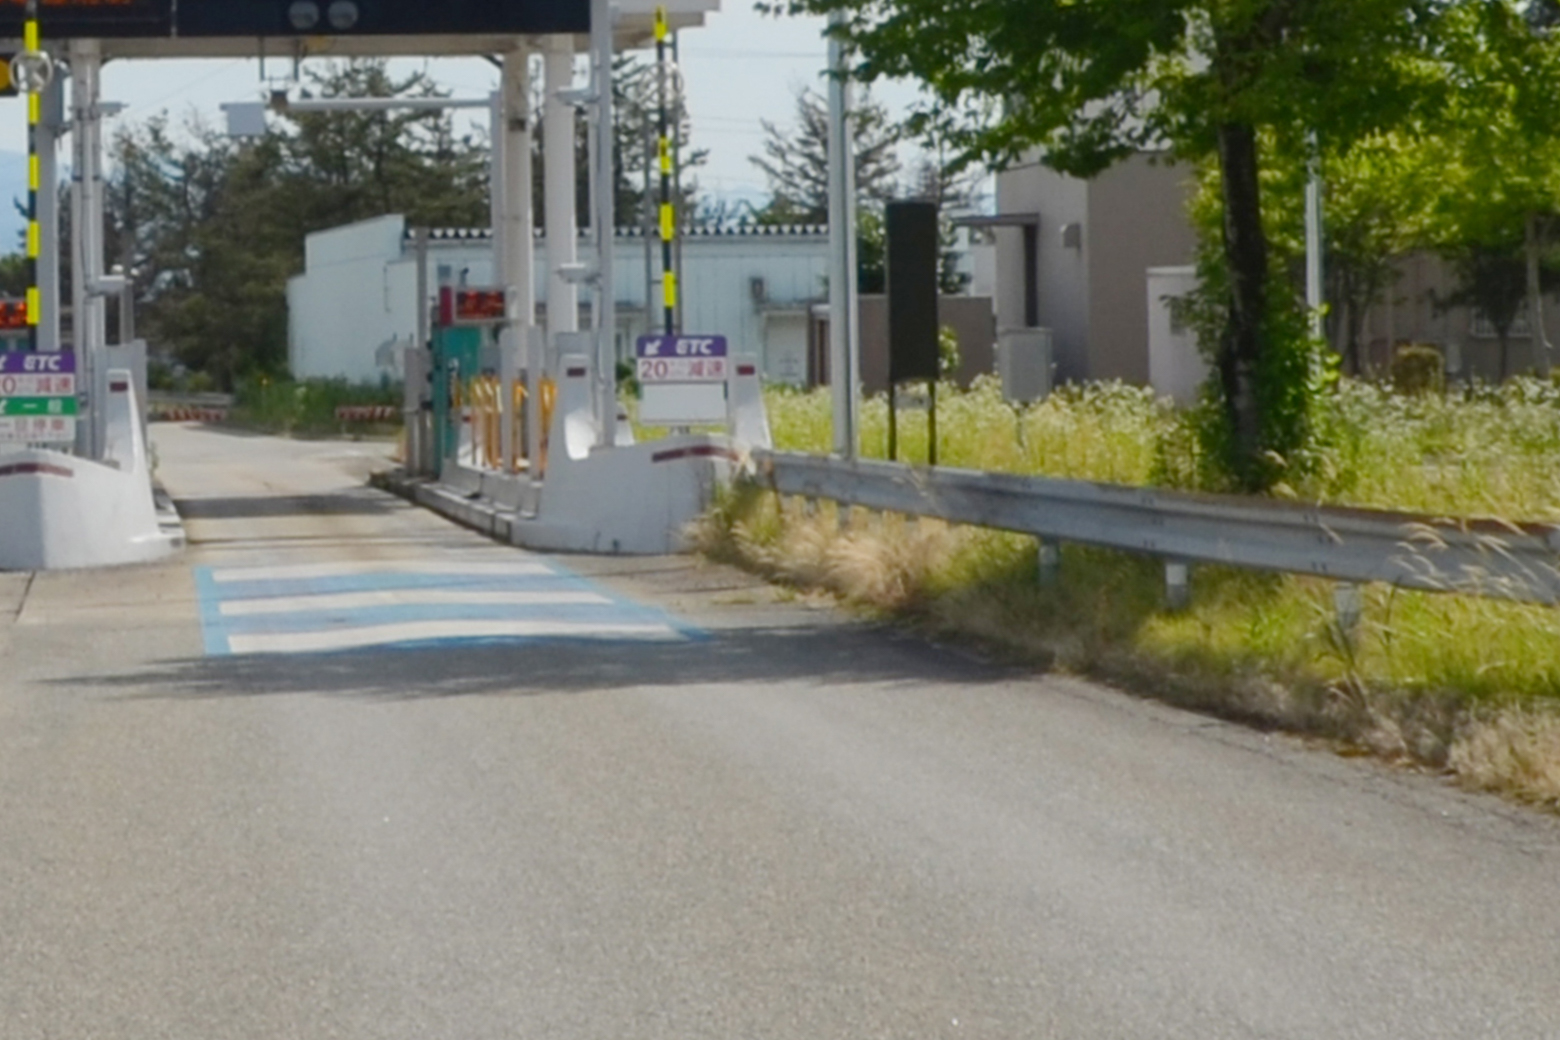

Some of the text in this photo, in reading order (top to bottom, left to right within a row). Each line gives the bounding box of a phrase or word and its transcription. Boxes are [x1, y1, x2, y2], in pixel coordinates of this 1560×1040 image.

[676, 339, 713, 355] ETC
[23, 355, 61, 371] ETC
[642, 361, 668, 378] 20
